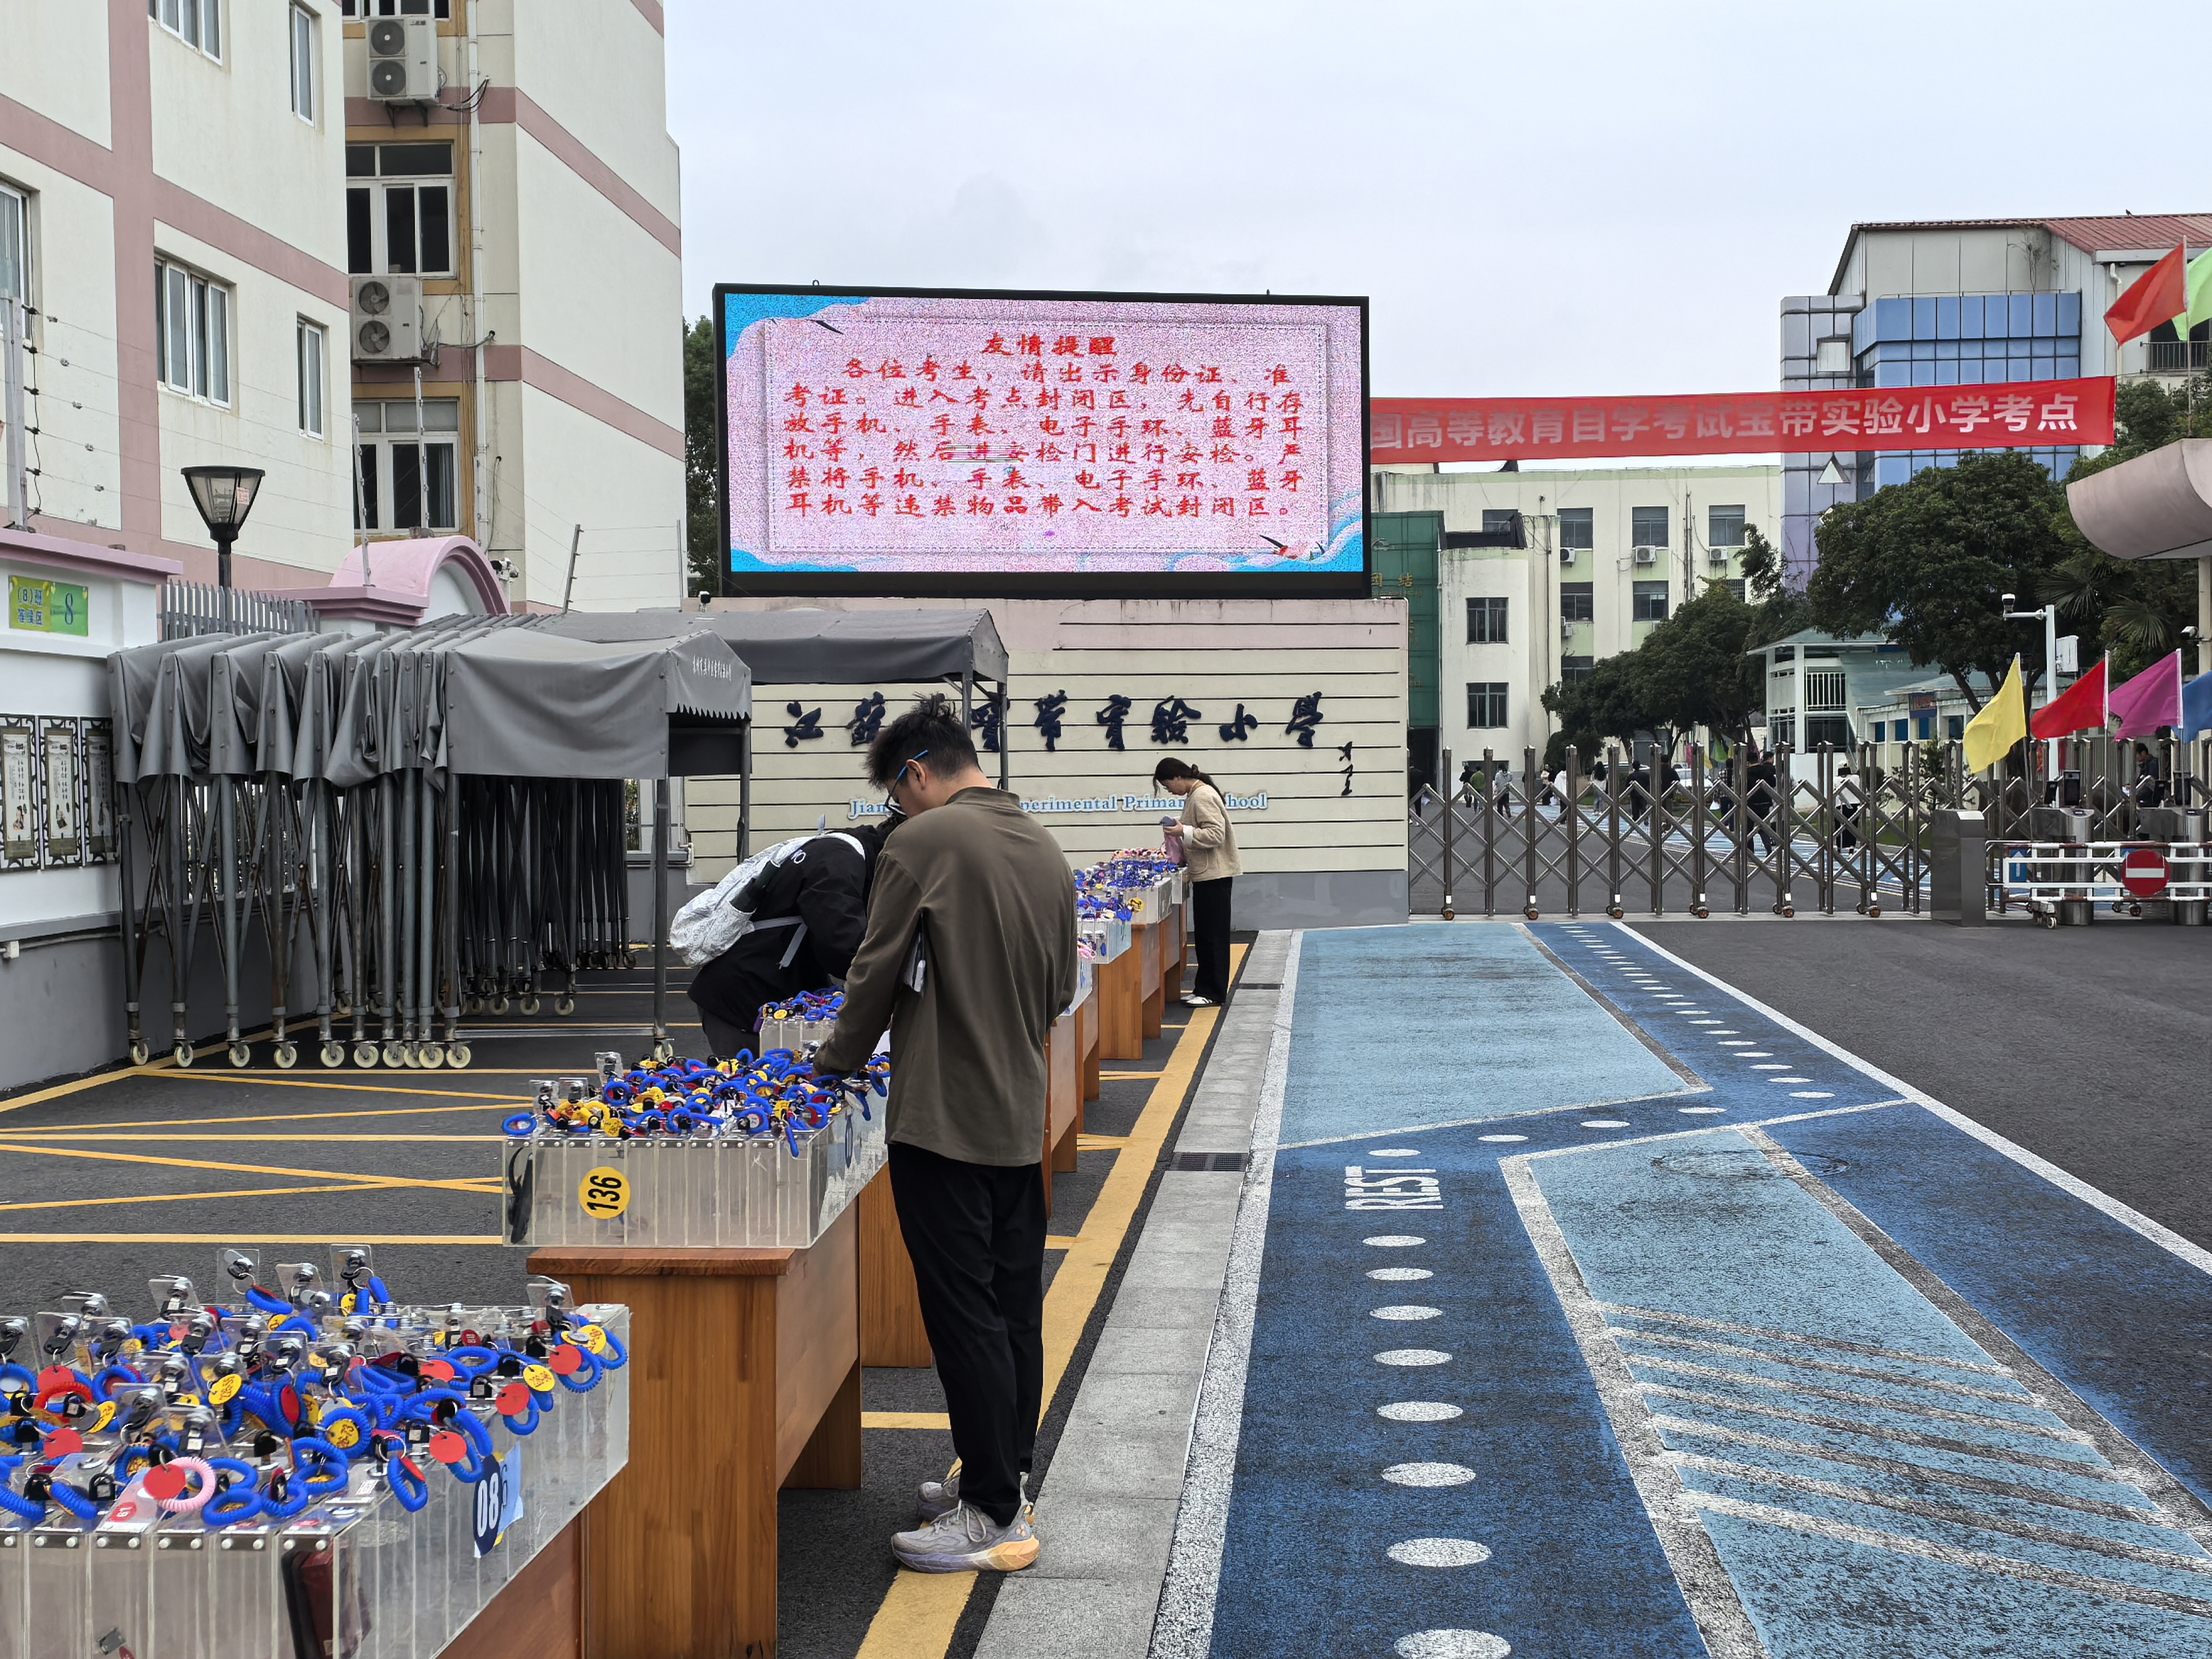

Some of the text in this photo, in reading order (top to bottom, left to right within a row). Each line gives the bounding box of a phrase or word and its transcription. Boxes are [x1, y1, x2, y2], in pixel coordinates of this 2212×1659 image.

[982, 332, 1118, 359] 友情提醒
[65, 592, 74, 625] 8
[1125, 795, 1184, 809] Primar
[586, 1175, 622, 1211] 136
[477, 1472, 499, 1537] 08
